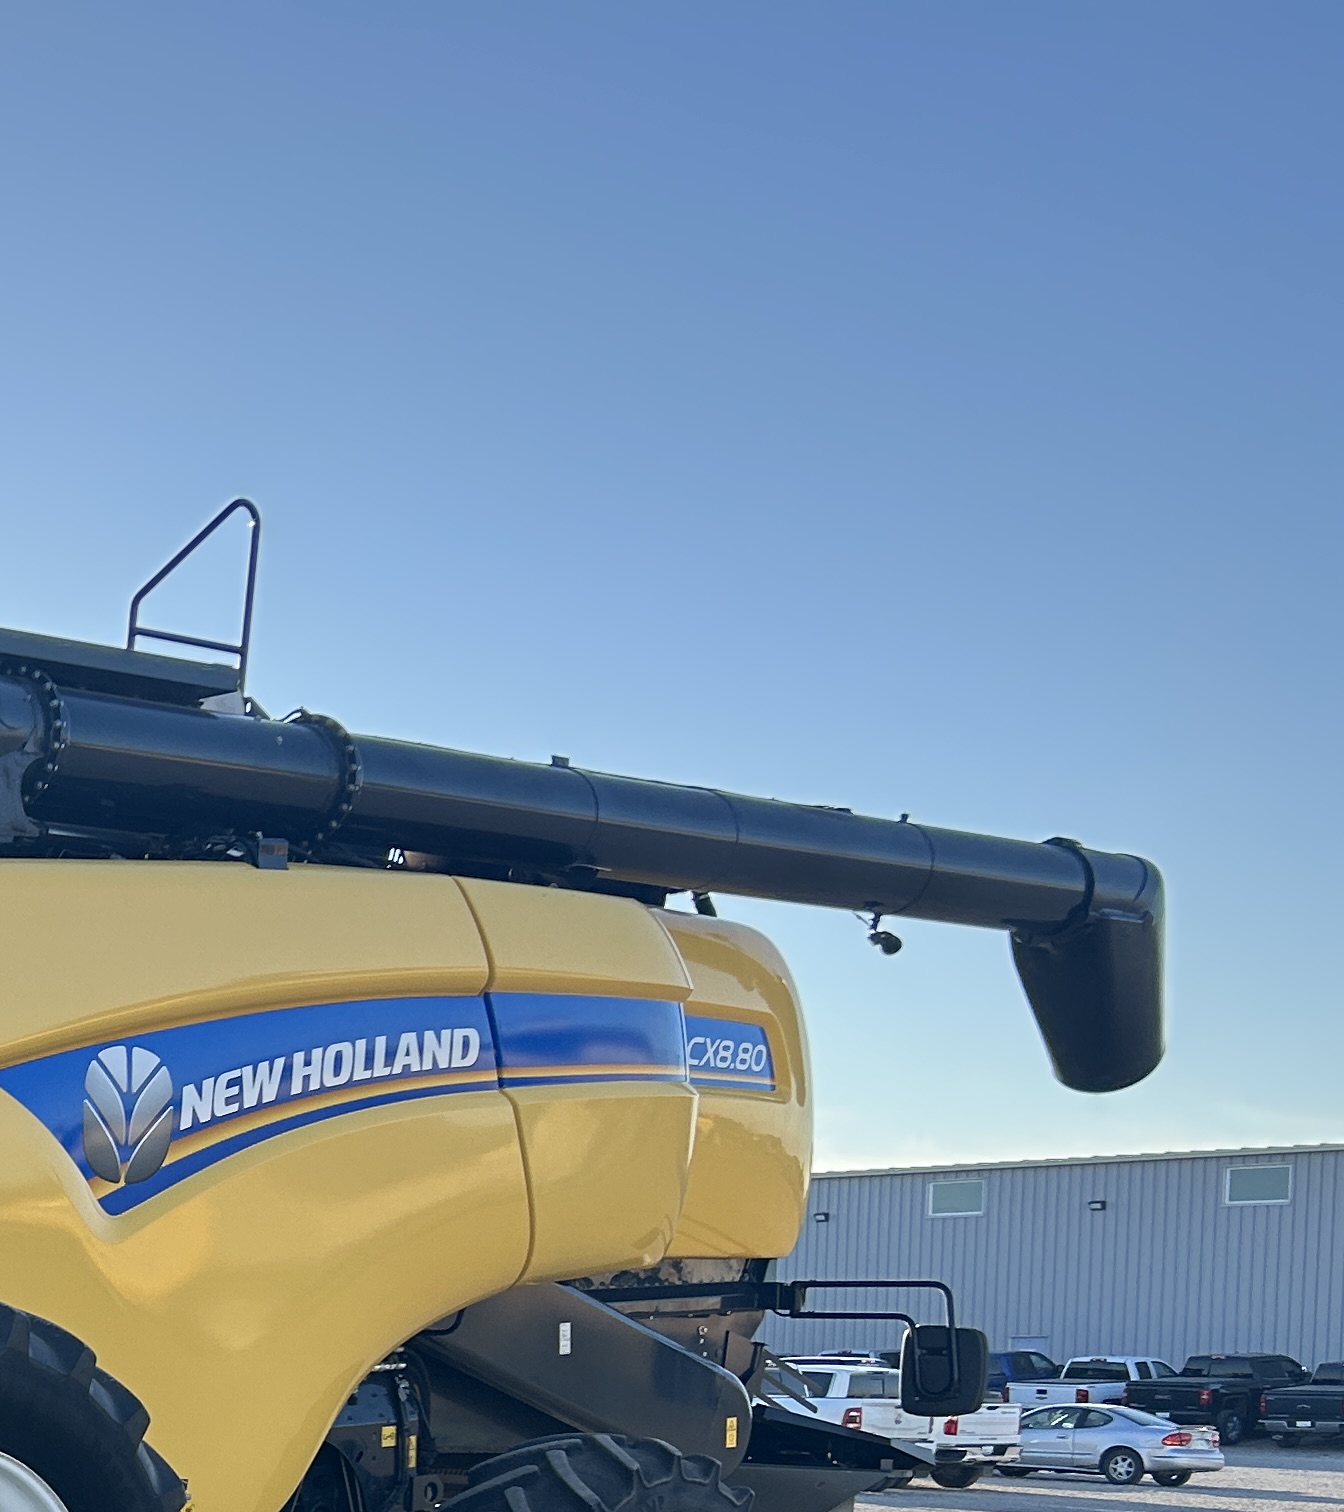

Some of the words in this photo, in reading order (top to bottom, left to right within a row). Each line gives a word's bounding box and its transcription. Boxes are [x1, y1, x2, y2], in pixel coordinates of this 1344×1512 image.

[179, 1056, 286, 1131] NEW
[290, 1027, 481, 1096] HOLLAND
[687, 1036, 767, 1072] CX8.80
